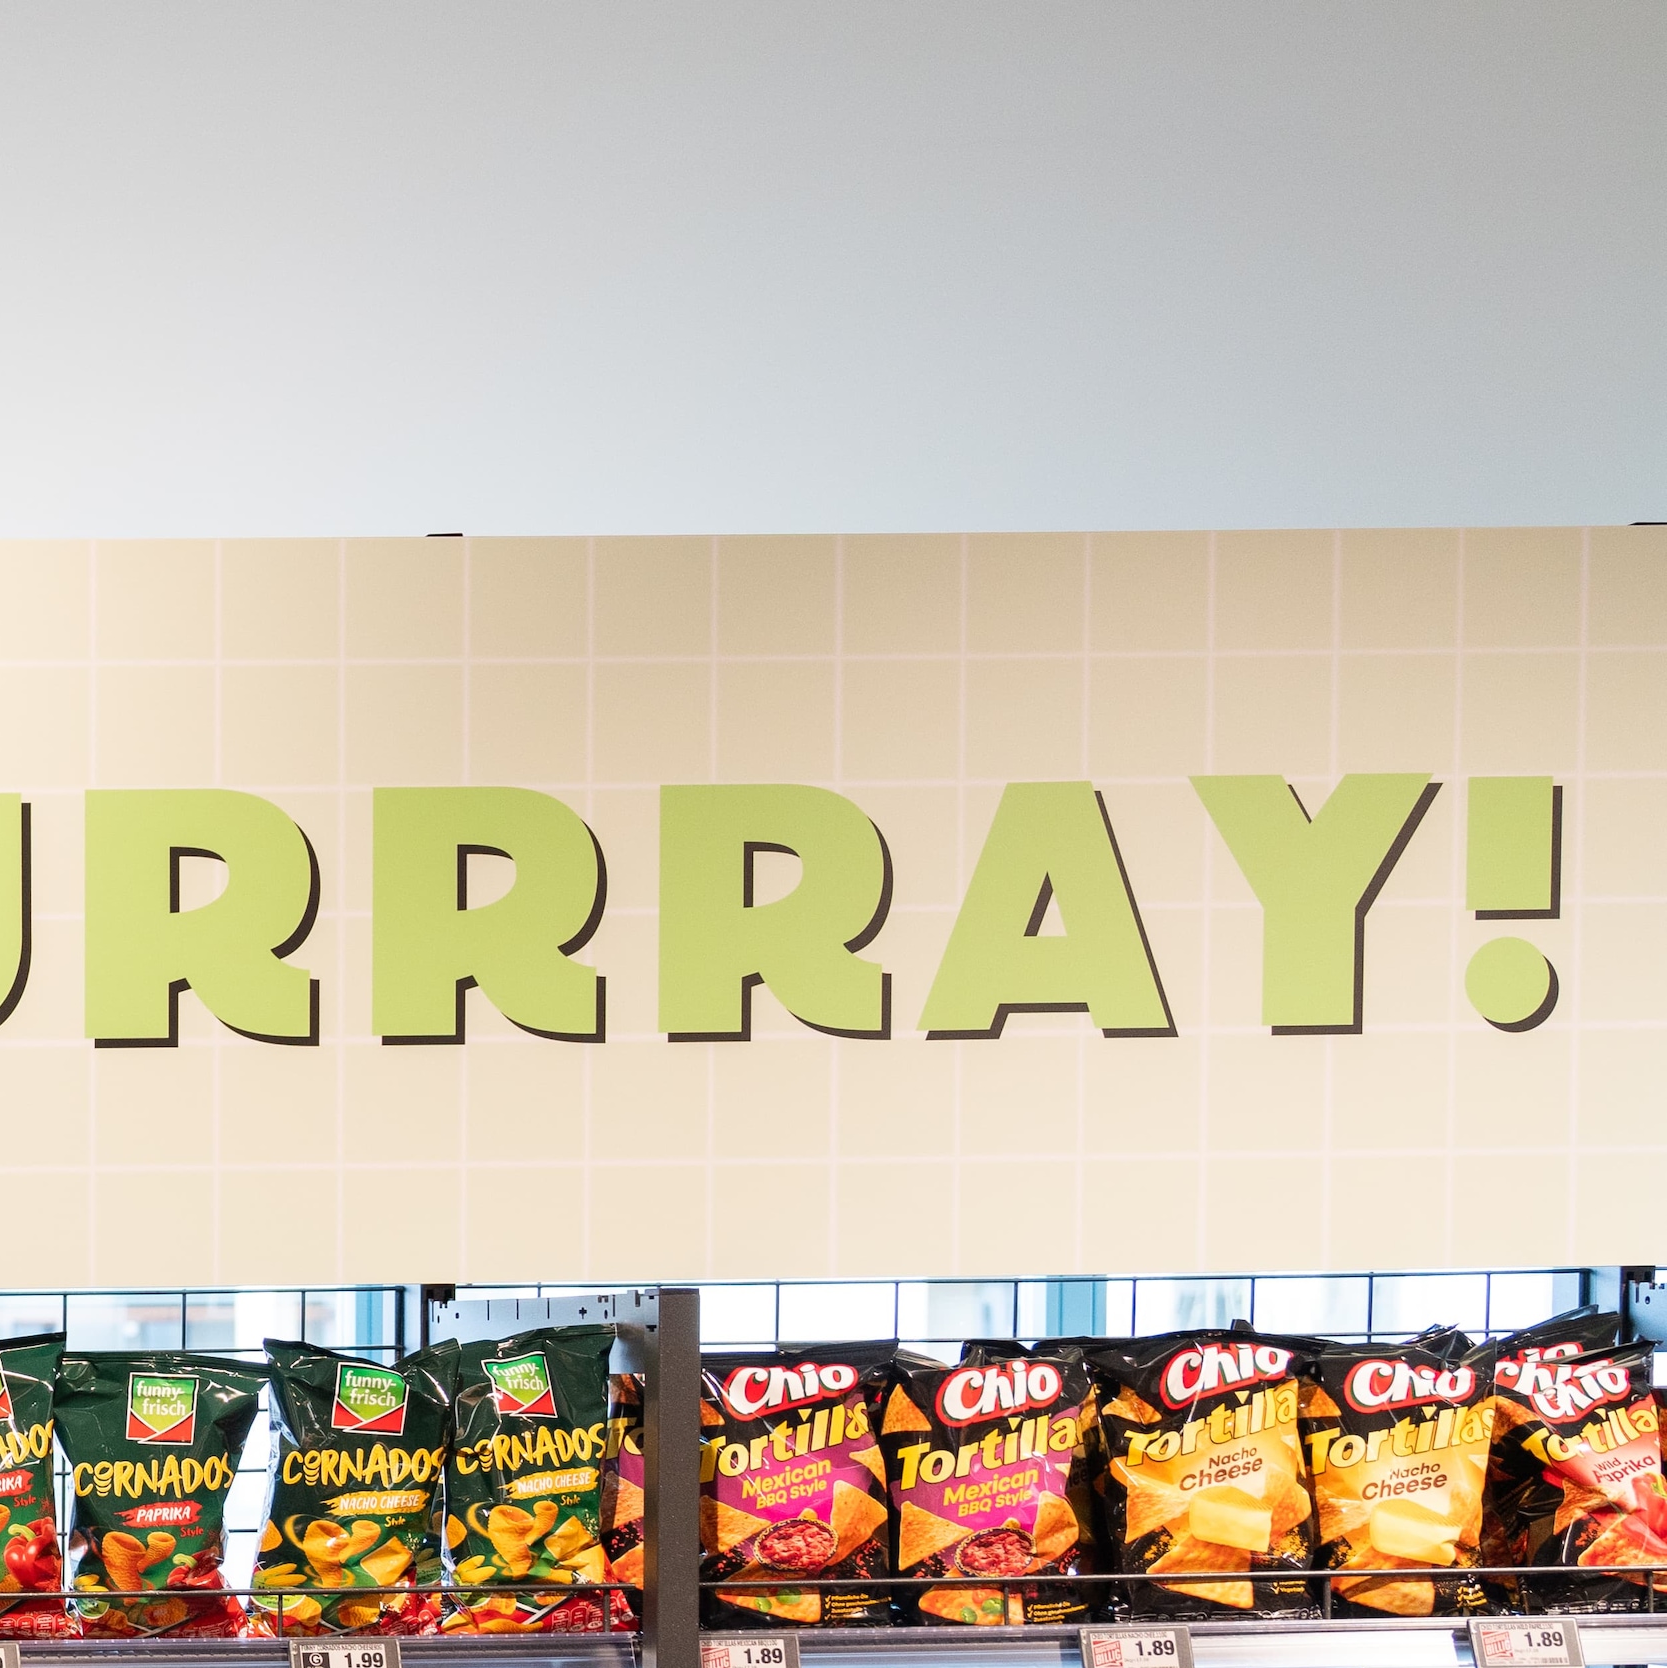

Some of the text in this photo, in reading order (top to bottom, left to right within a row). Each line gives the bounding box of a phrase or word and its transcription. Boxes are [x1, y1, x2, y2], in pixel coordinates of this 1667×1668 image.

[136, 1382, 183, 1400] funny-
[727, 1362, 857, 1414] Chio
[141, 1398, 187, 1416] frisch
[1208, 1445, 1257, 1468] Nacho
[741, 1460, 832, 1498] Mexican
[1179, 1458, 1263, 1491] Cheese
[339, 1493, 420, 1511] NACHO CHEESE
[743, 1645, 783, 1666] 1.89
[1135, 1639, 1174, 1658] 1.89
